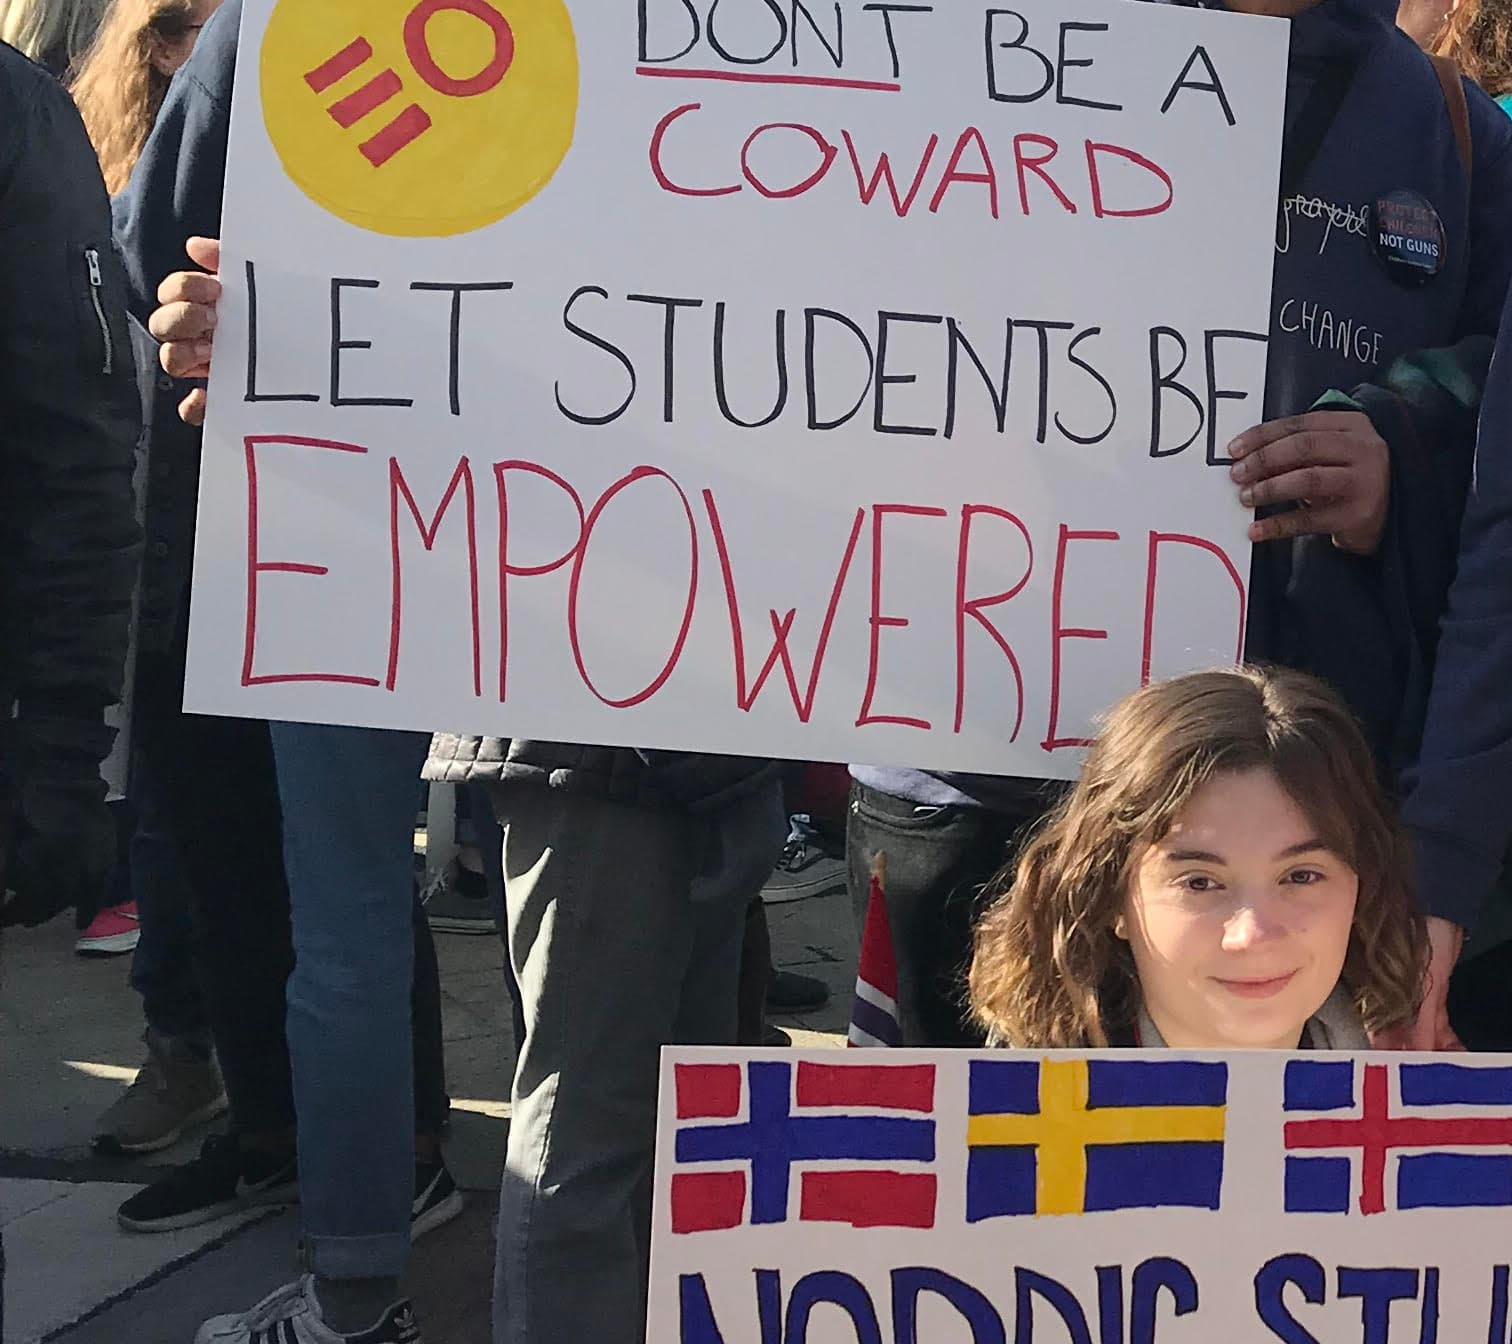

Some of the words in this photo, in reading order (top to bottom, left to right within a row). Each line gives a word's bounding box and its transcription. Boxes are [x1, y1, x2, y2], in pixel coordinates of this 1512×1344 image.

[986, 9, 1123, 111] BE
[1160, 45, 1236, 127] A
[649, 103, 1173, 218] COWARD
[1379, 232, 1403, 250] NOT
[1406, 237, 1440, 258] GUNS
[244, 260, 513, 416] LET
[555, 286, 1116, 446] STUDENTS
[1150, 325, 1269, 467] BE
[1279, 299, 1384, 366] CHANGE
[241, 435, 1247, 753] EMPOWERED
